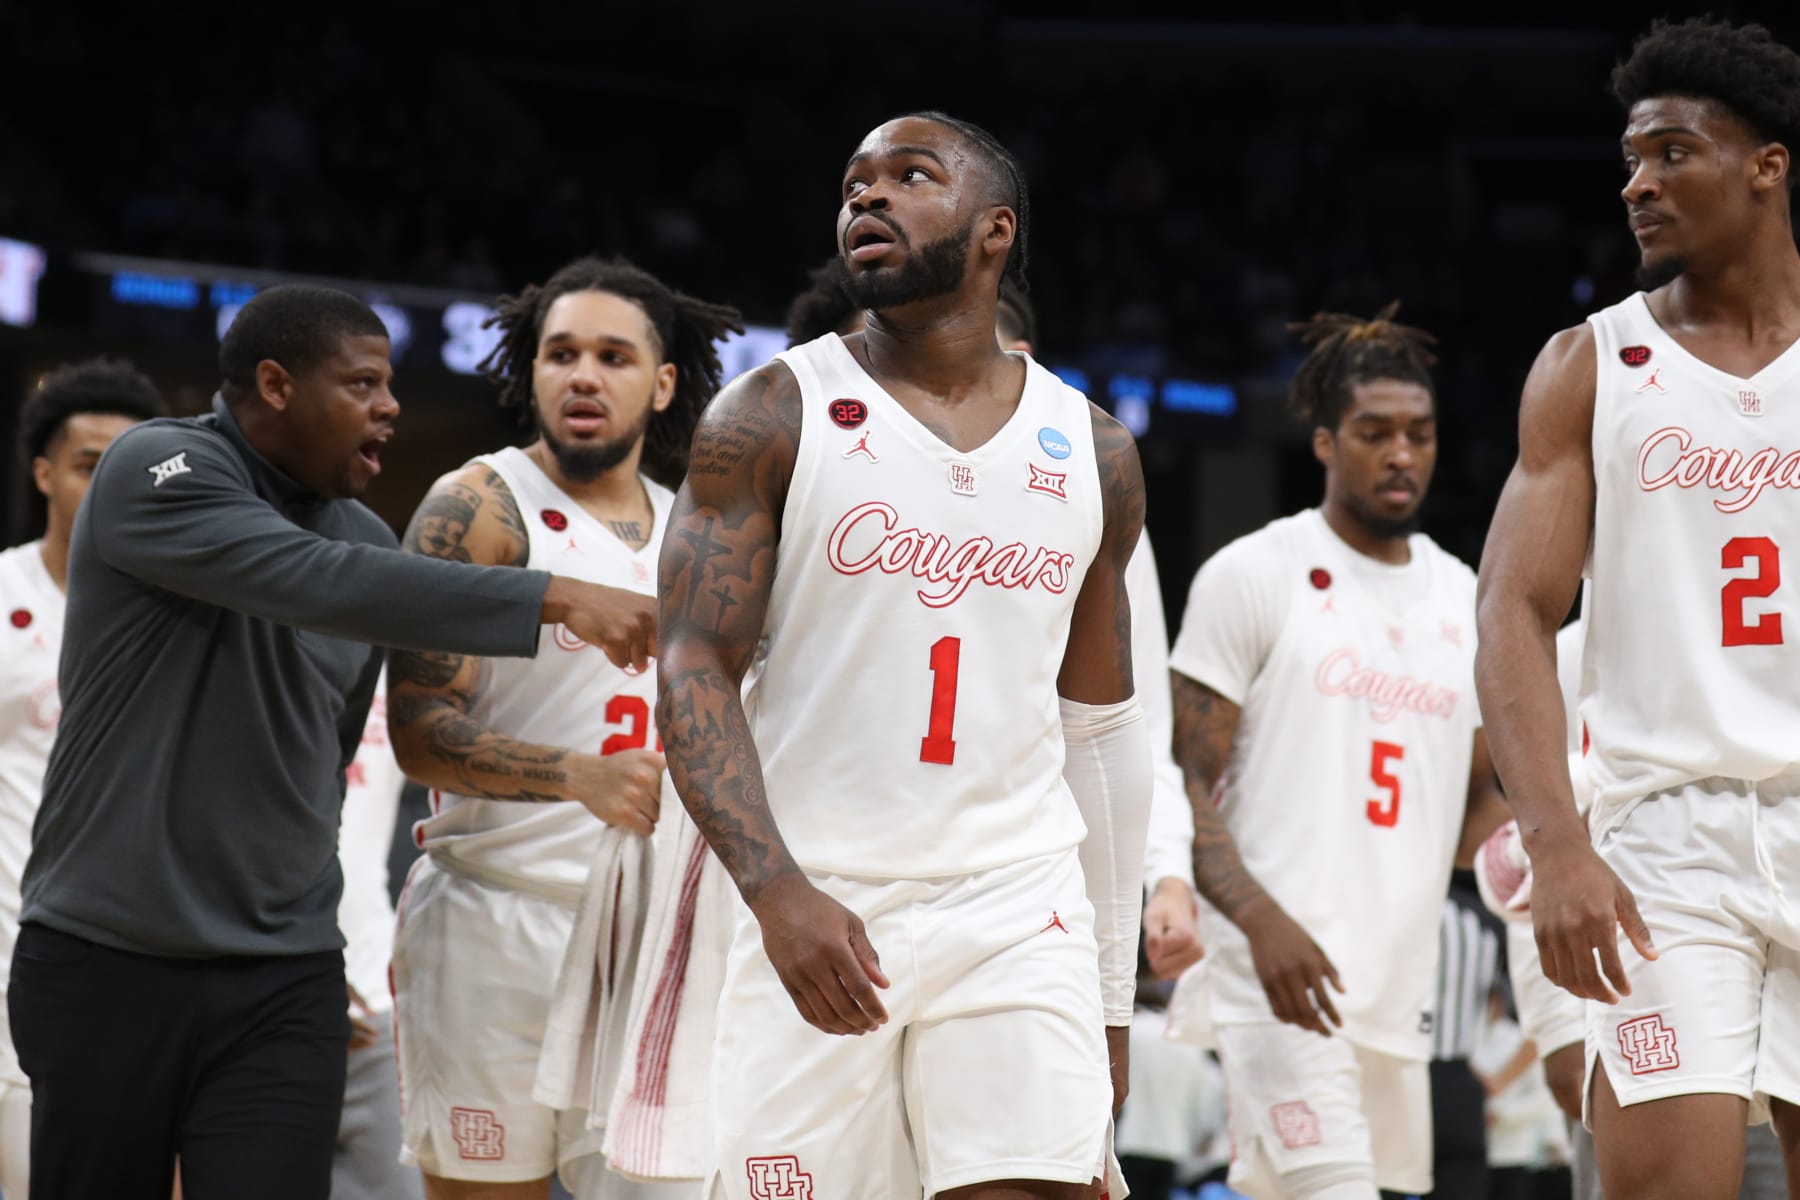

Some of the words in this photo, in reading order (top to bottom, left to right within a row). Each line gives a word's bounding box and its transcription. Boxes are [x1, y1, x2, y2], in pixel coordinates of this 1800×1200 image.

[835, 404, 861, 421] 32
[1043, 439, 1070, 454] NCAA
[827, 501, 1075, 609] Cougars
[1722, 537, 1783, 646] 2
[601, 694, 665, 756] 2
[920, 636, 960, 765] 1
[1366, 740, 1404, 828] 5
[1620, 1017, 1676, 1072] UH
[452, 1110, 501, 1158] UH
